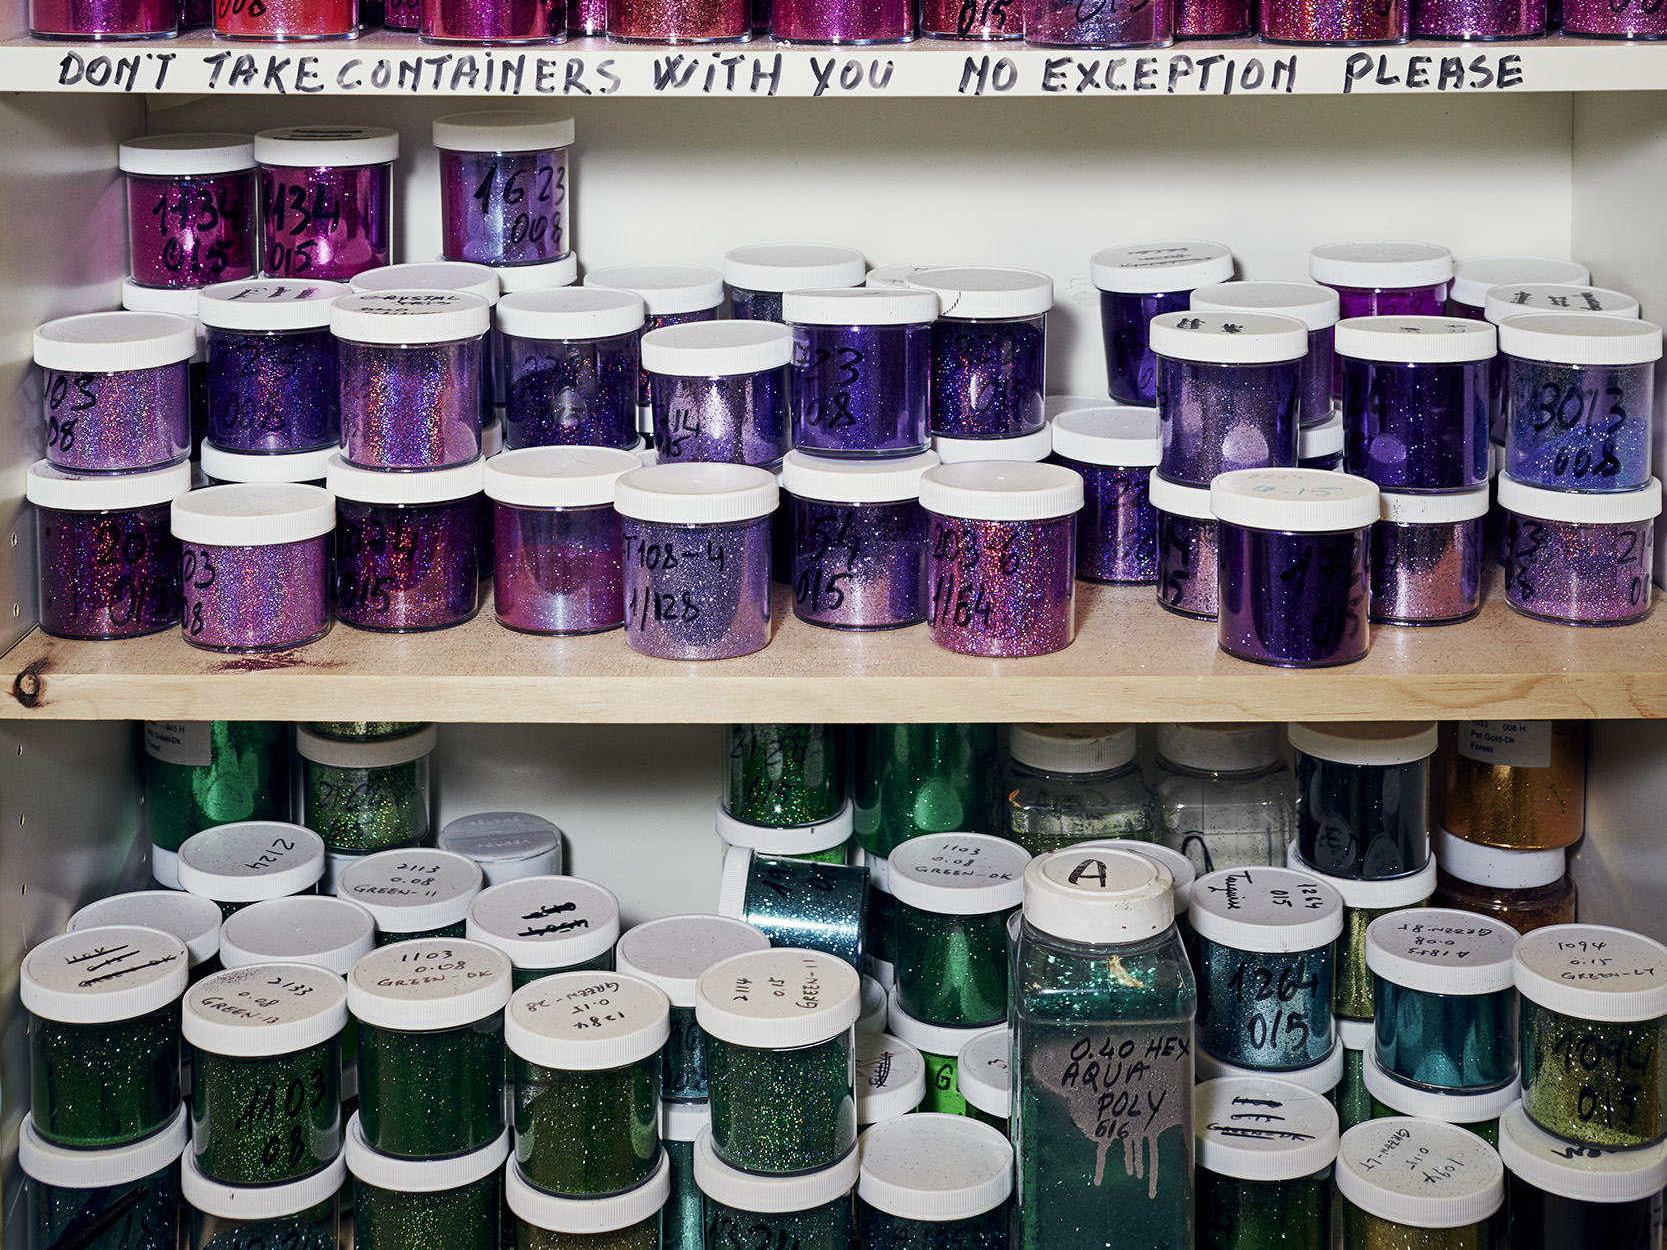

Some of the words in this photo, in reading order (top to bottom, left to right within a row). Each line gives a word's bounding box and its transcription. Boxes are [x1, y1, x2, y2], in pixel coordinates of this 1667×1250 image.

[58, 50, 177, 92] DON'T
[203, 50, 325, 95] TAKE
[809, 57, 895, 97] YOU
[958, 56, 1018, 96] NO
[1042, 53, 1298, 95] EXCEPTION
[1344, 52, 1524, 94] PLEASE
[1067, 857, 1109, 889] A
[399, 949, 455, 964] 1103
[1557, 939, 1608, 953] 1094
[1246, 1009, 1309, 1053] 015
[1068, 1036, 1136, 1062] 0.40
[1143, 1036, 1192, 1062] HEX
[1060, 1059, 1152, 1089] AQUA
[1096, 1088, 1167, 1132] POLY
